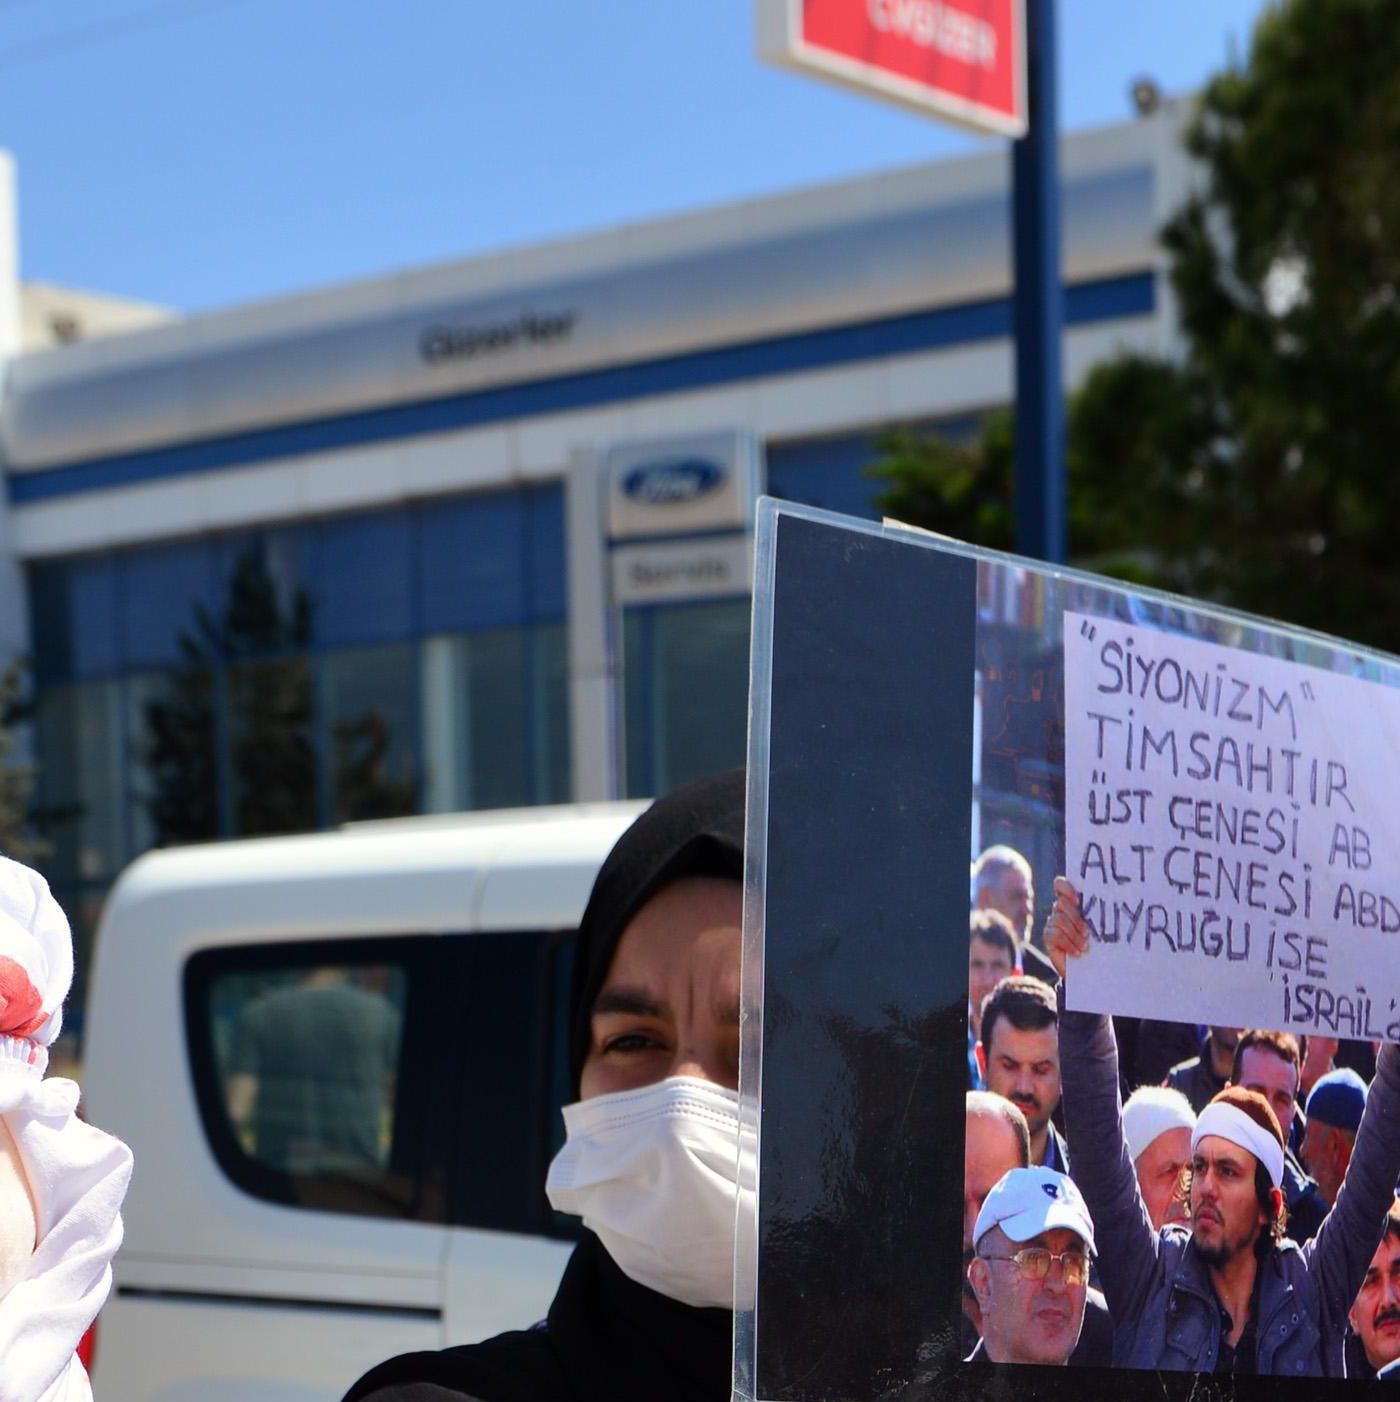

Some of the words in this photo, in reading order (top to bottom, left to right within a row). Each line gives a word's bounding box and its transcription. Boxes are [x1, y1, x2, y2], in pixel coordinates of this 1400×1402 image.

[1088, 769, 1152, 826] ÜST
[1168, 796, 1301, 858] ÇENESİ
[1328, 823, 1372, 871] AB
[1080, 842, 1153, 885] ALT
[1163, 846, 1313, 919] ÇENESİ
[1077, 891, 1251, 962] KUYRUĞU
